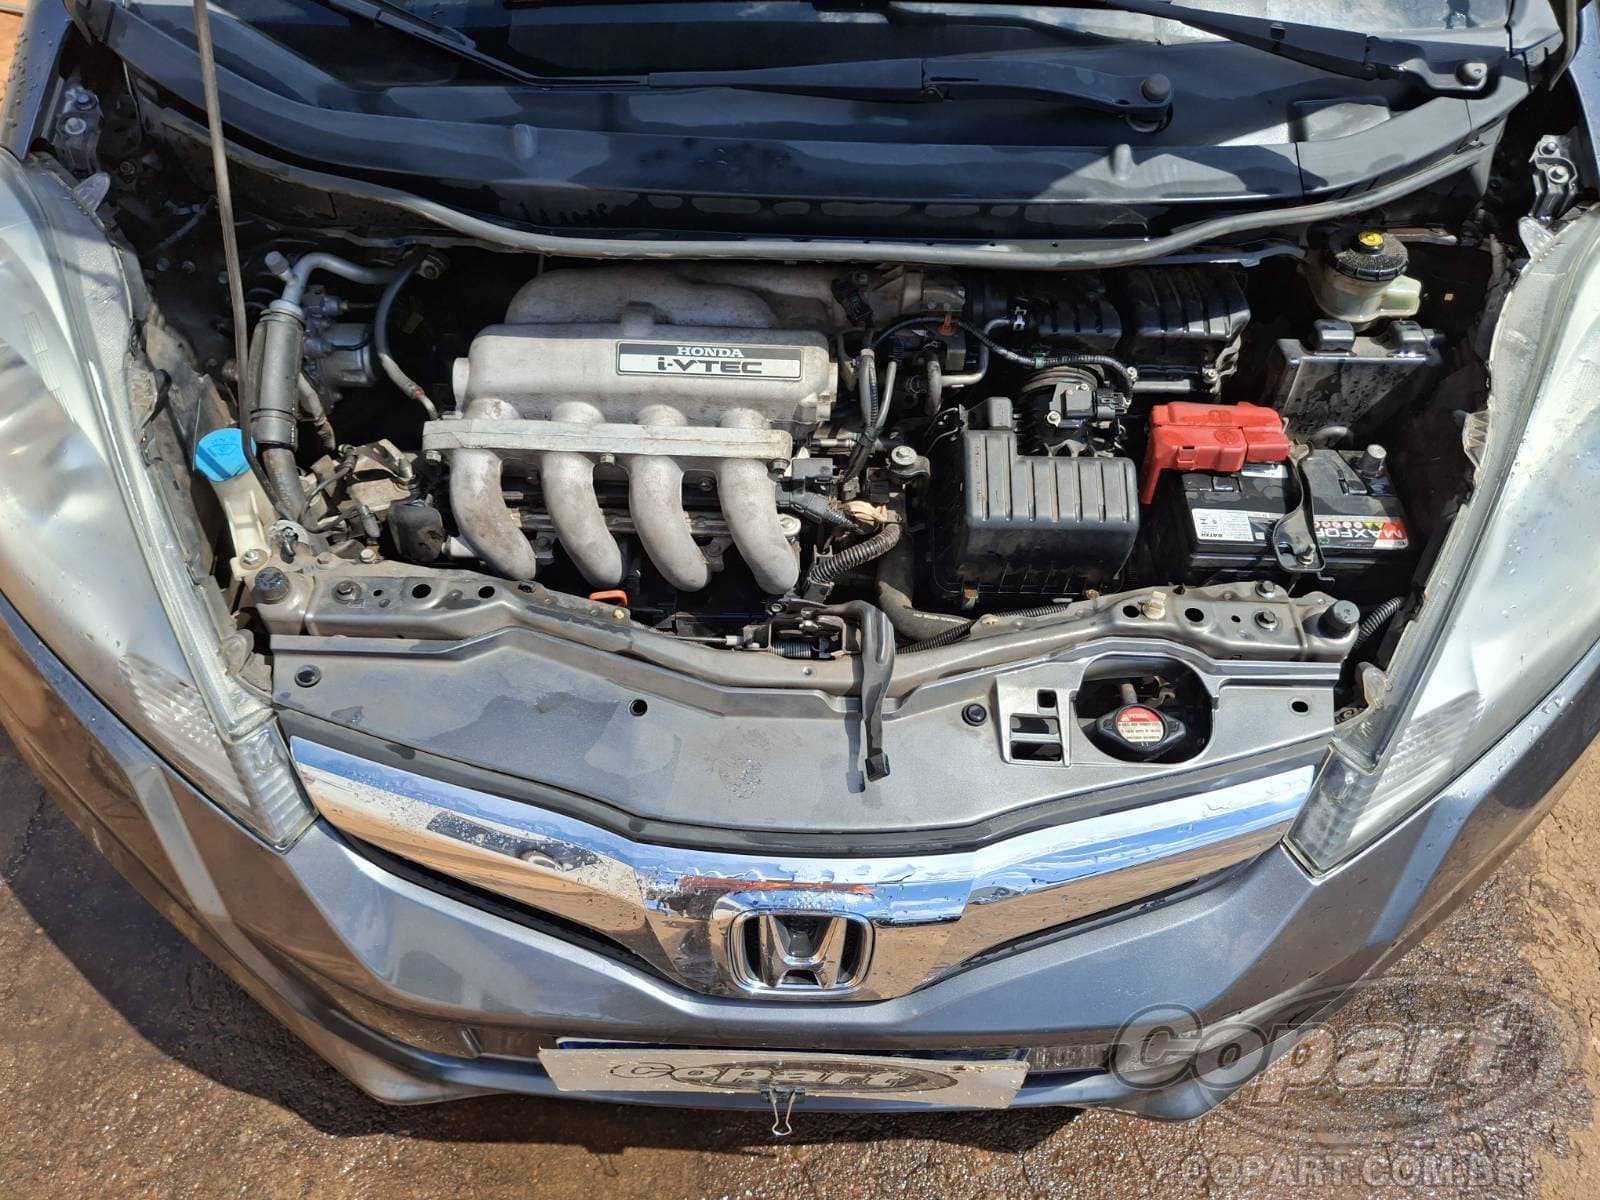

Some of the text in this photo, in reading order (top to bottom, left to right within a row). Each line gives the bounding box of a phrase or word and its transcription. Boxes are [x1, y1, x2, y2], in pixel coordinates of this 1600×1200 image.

[676, 346, 744, 358] HONDA
[657, 357, 763, 374] i-VTEC
[610, 1062, 912, 1089] Copart
